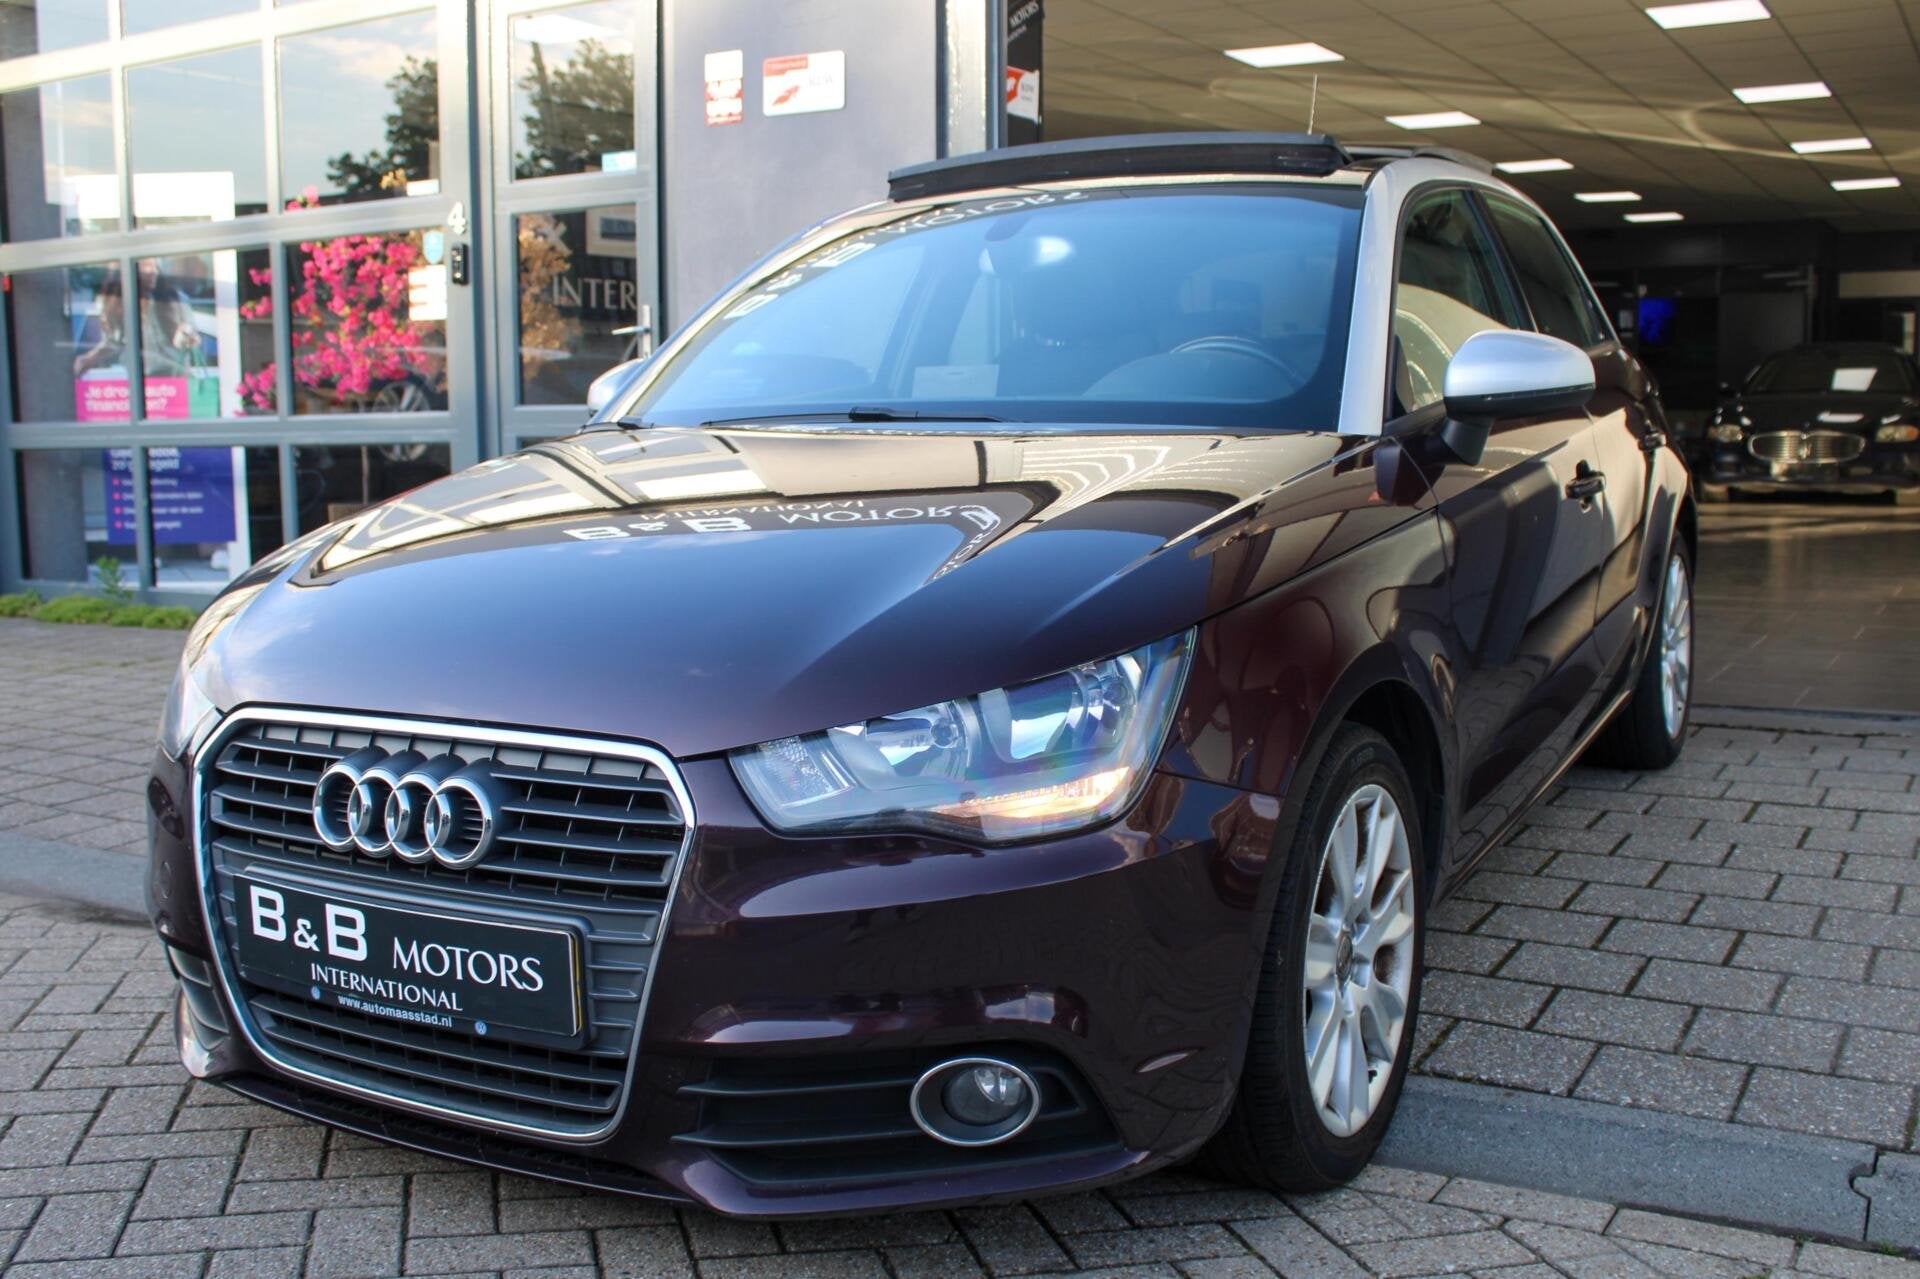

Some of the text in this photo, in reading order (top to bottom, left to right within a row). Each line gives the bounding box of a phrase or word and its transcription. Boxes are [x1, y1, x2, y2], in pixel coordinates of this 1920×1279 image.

[310, 962, 464, 1012] INTERNATIONAL
[392, 936, 545, 993] MOTORS
[337, 995, 453, 1028] www.automaasstad.nl
